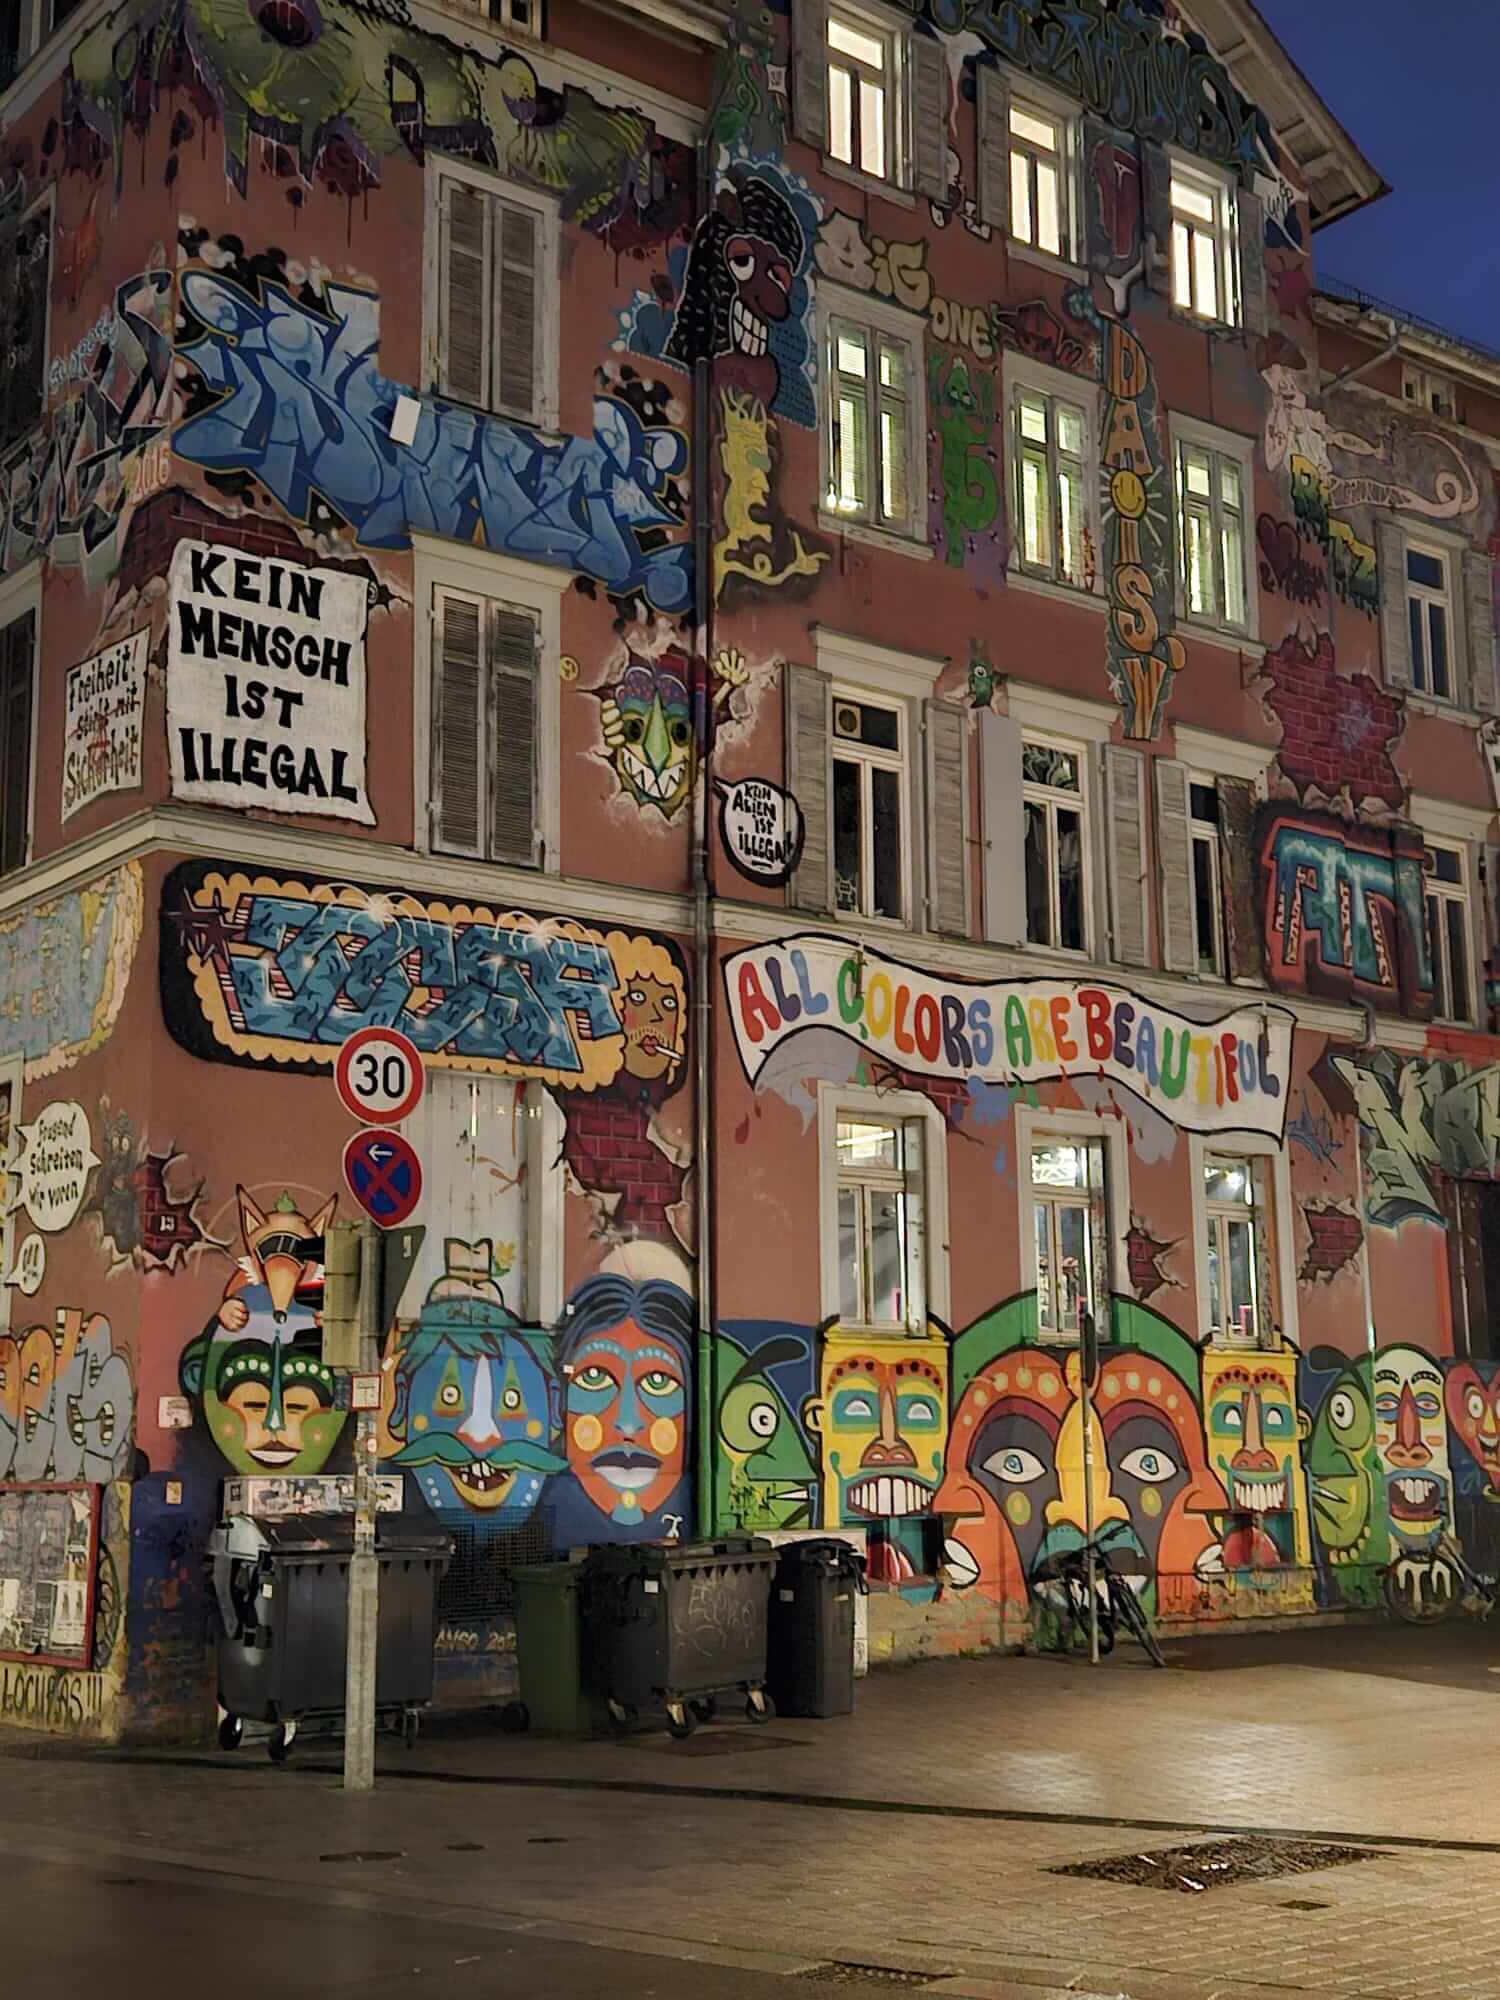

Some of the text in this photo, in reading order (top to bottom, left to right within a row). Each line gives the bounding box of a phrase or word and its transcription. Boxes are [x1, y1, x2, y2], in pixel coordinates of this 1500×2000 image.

[190, 549, 325, 621] KEIN
[177, 600, 352, 687] MENSCH
[224, 674, 304, 729] IST
[178, 727, 358, 804] ILLEGAL
[738, 949, 829, 1043] ALL
[837, 958, 994, 1069] COLORS
[1004, 994, 1078, 1068] ARE
[1077, 989, 1281, 1108] BEAUTIFUL
[356, 1053, 405, 1098] 30
